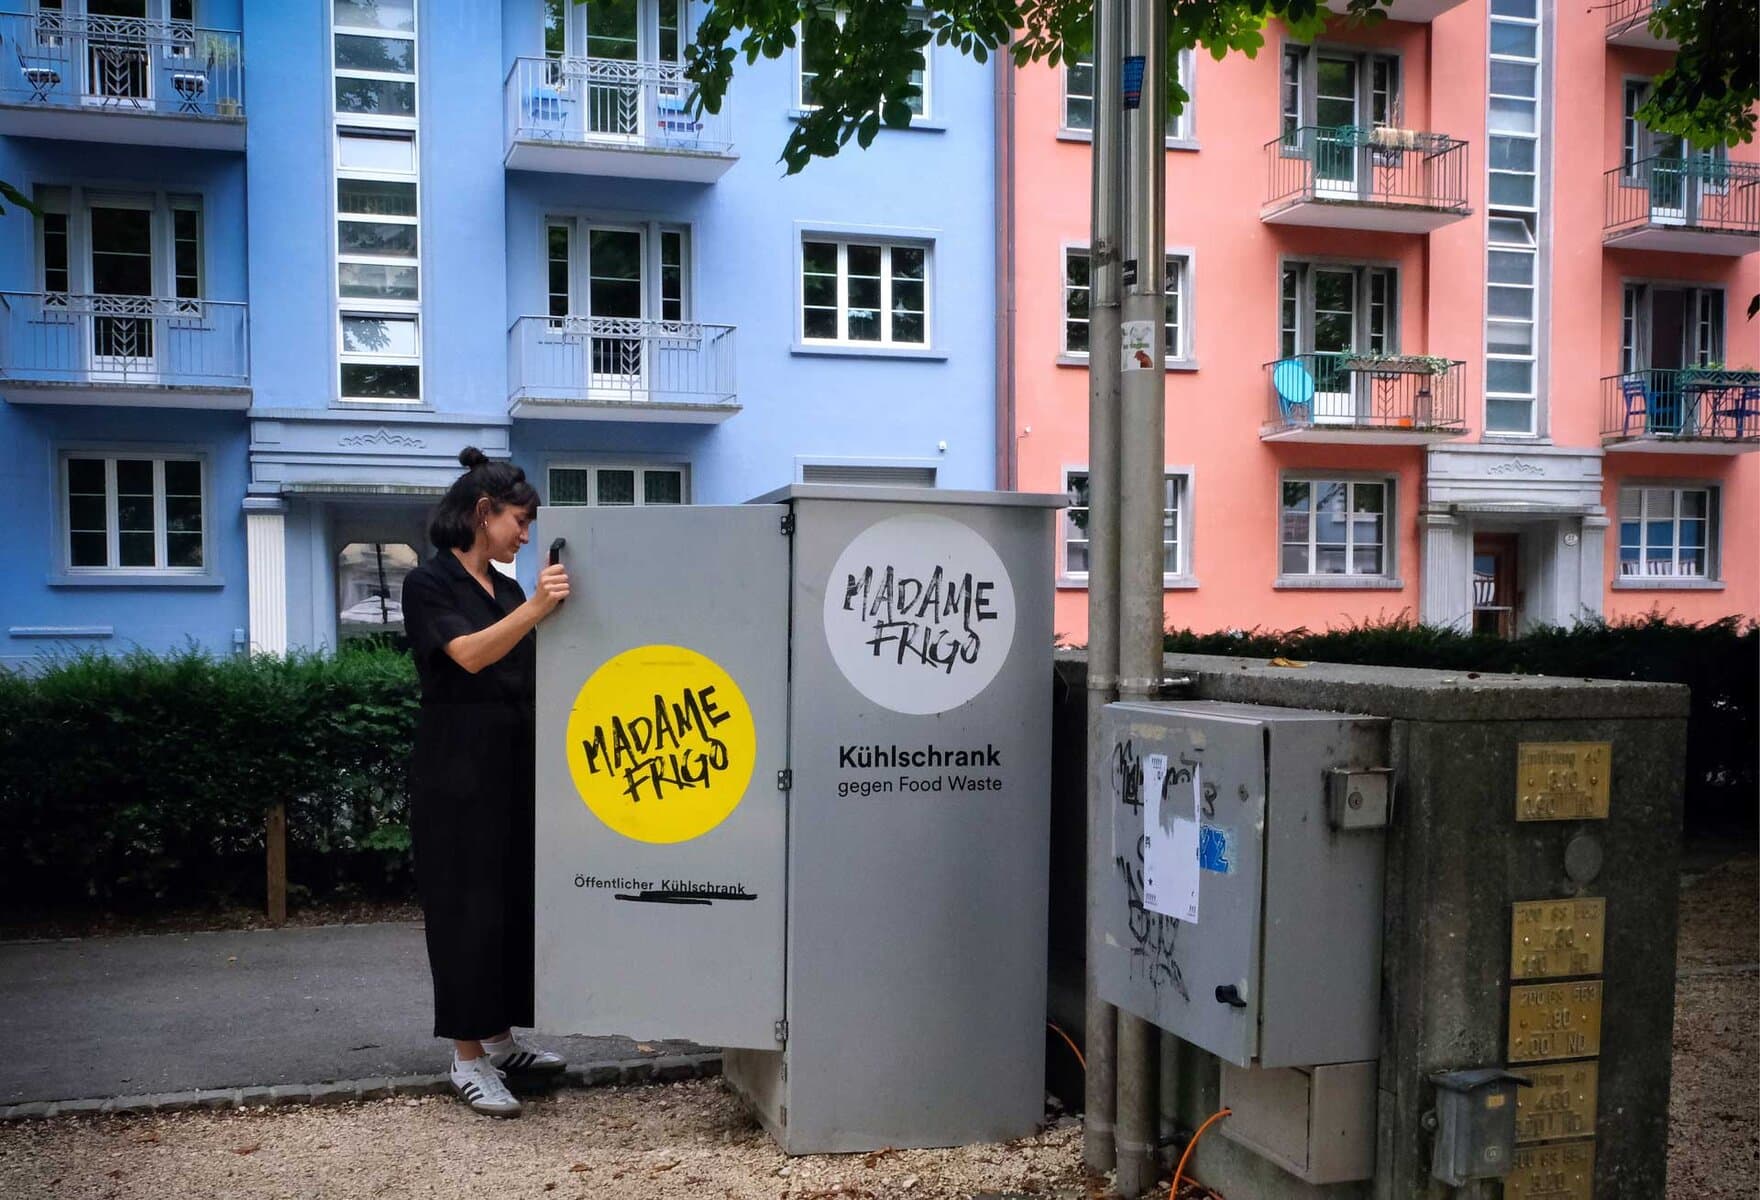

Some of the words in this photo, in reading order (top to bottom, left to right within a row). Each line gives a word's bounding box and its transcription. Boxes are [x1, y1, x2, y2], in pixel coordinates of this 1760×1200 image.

[843, 565, 998, 631] MADAME
[866, 620, 981, 674] FRIGO
[582, 685, 731, 777] MADAME
[839, 744, 1001, 768] Kühlschrank
[623, 737, 729, 802] FRIGO
[838, 781, 893, 797] gegen
[899, 776, 942, 791] Food
[948, 776, 1002, 791] Waste
[574, 873, 653, 890] Öffentlicher
[661, 879, 745, 895] Kühlschrank
